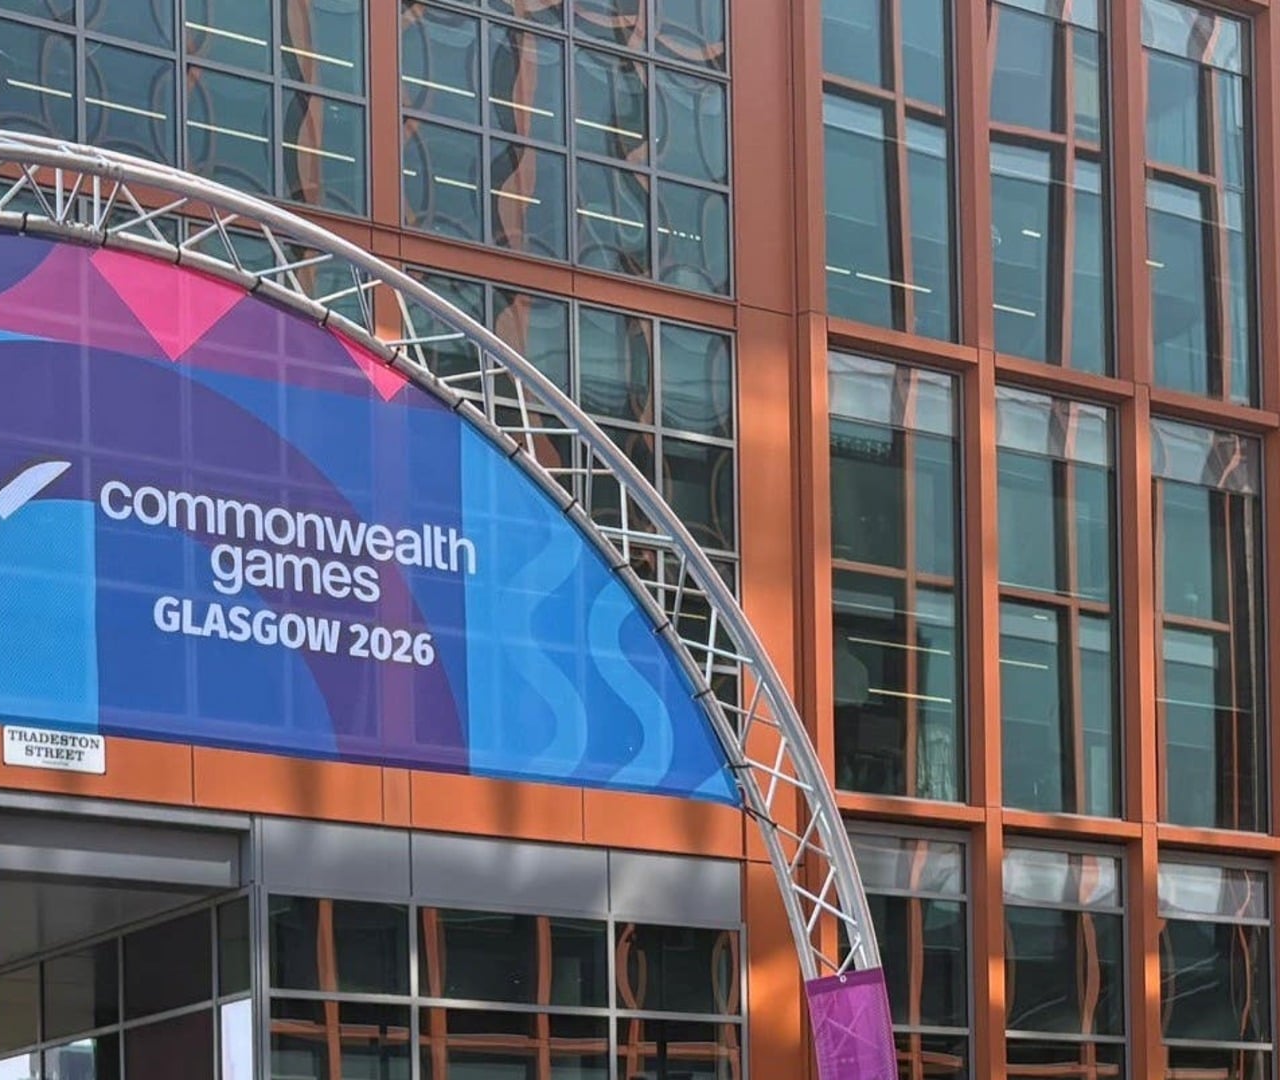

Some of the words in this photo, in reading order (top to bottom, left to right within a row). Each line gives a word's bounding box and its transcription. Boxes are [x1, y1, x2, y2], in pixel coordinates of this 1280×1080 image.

[100, 480, 477, 575] commonwealth
[211, 543, 381, 602] games
[153, 596, 341, 653] GLASGOW
[349, 623, 436, 666] 2026
[7, 729, 100, 750] TRADESTON
[24, 745, 85, 761] STREET
